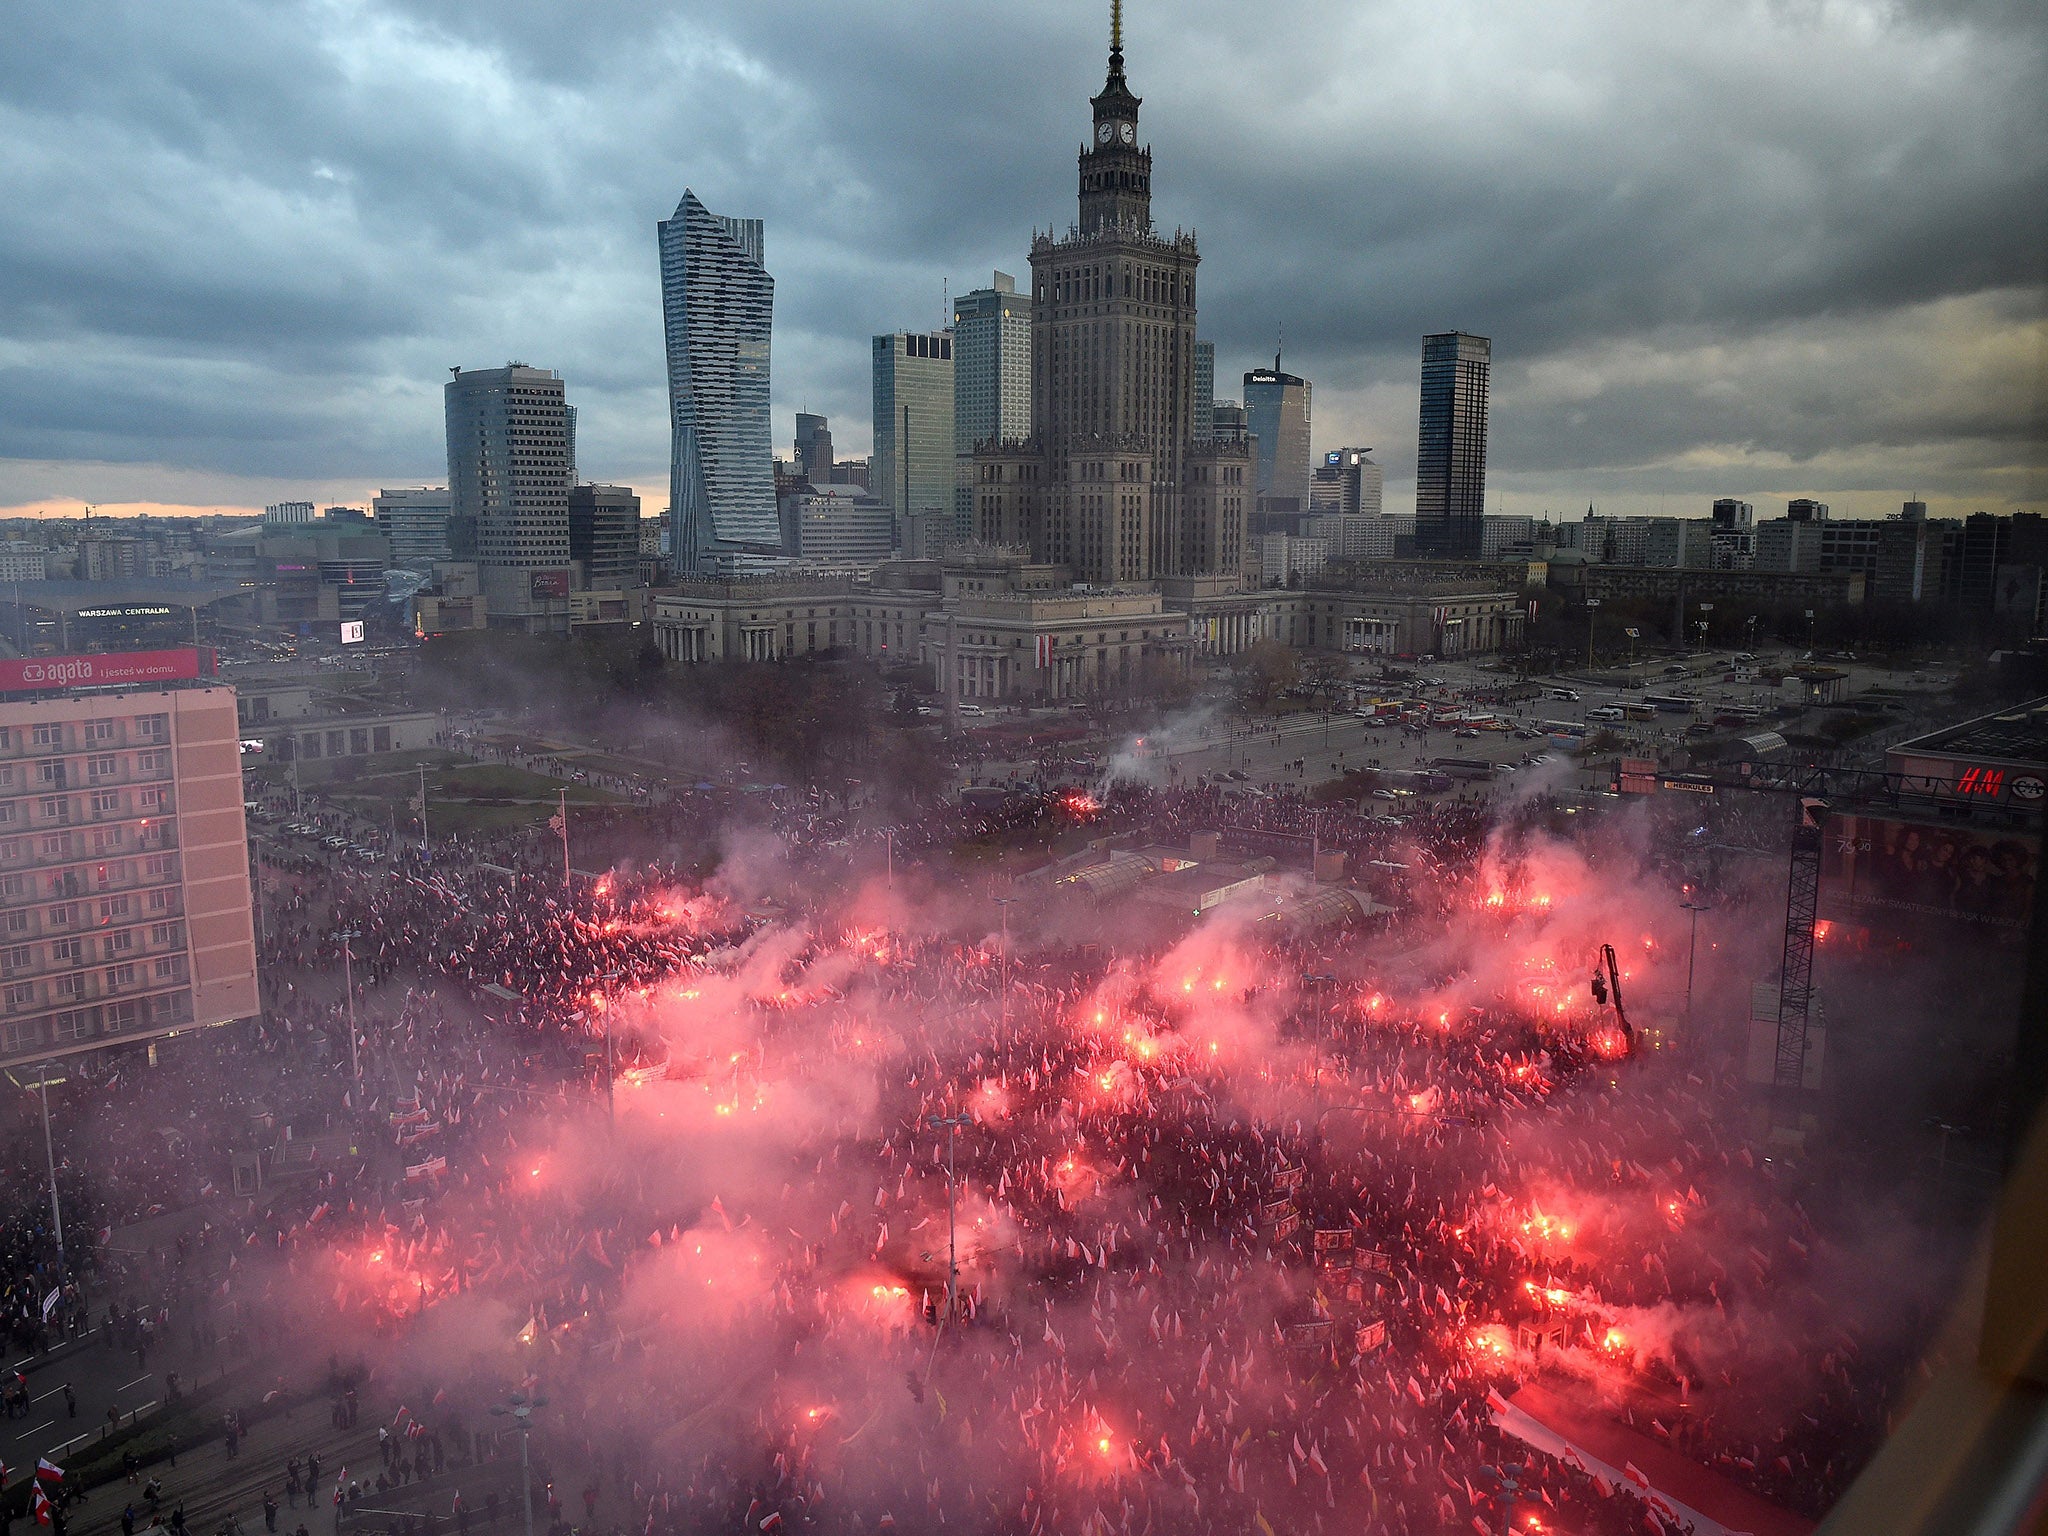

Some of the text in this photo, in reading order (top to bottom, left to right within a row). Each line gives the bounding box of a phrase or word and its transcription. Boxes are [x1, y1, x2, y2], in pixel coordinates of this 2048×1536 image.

[78, 607, 170, 617] WARSZAWA CENTRALNA
[47, 659, 92, 685] agata
[105, 666, 134, 678] jesteś
[146, 665, 176, 674] domu.
[1673, 782, 1712, 791] HERKULES
[1956, 767, 2005, 798] H&M
